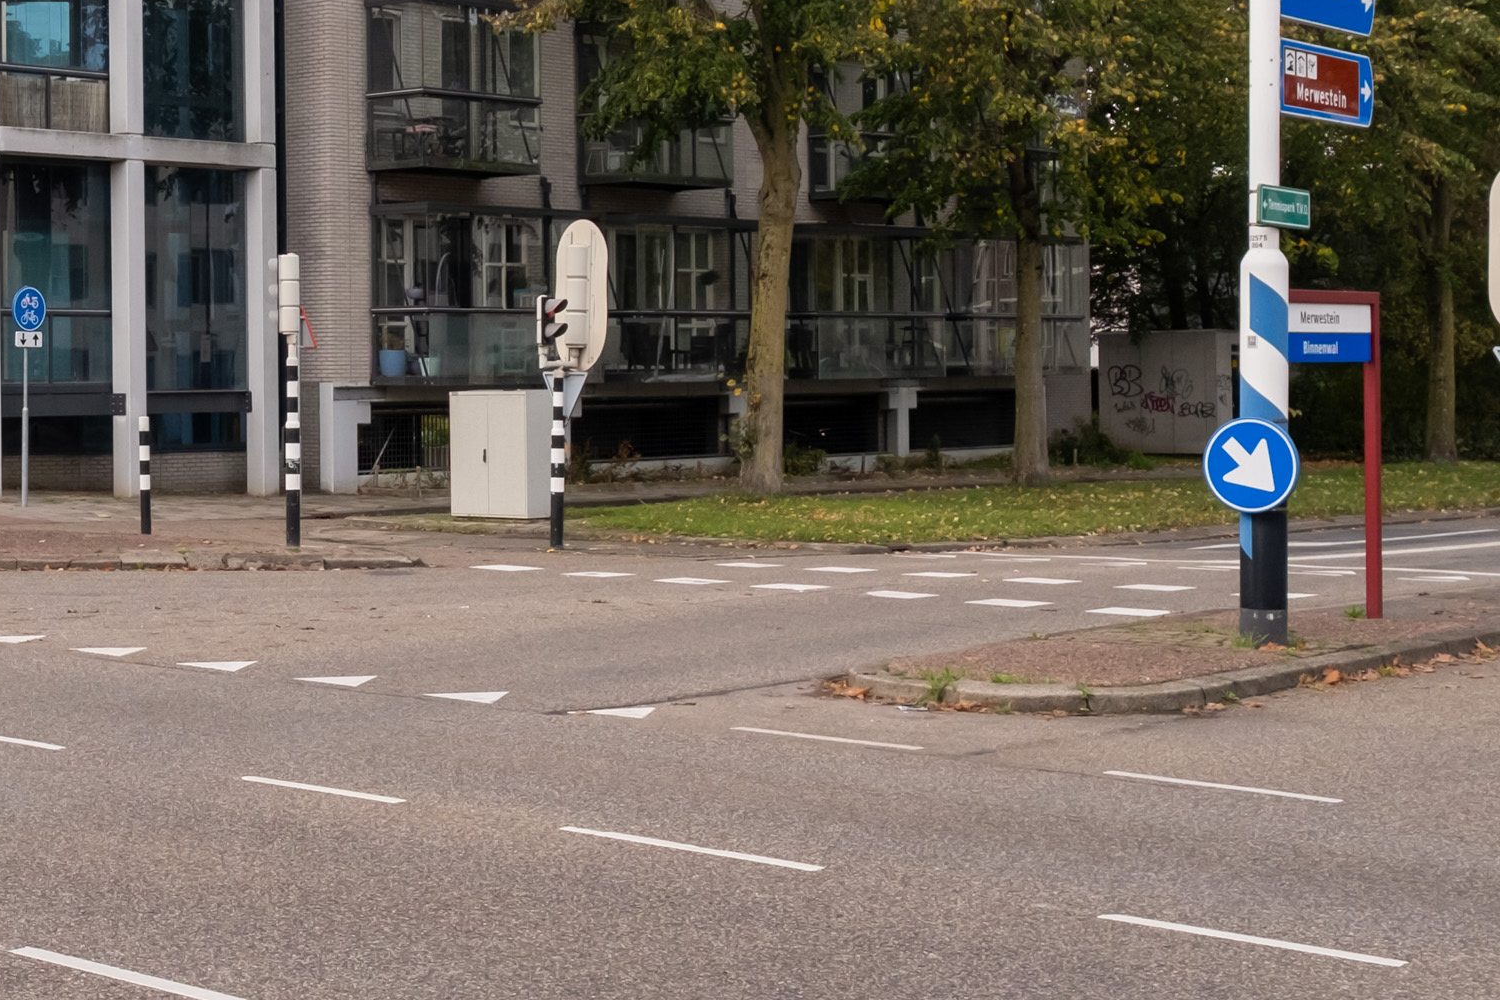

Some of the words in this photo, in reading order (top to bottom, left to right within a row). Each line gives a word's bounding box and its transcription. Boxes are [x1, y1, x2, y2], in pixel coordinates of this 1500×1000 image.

[1296, 82, 1347, 109] Merwestein
[1300, 311, 1340, 325] Merwestein
[1303, 340, 1339, 355] Binnenwal
